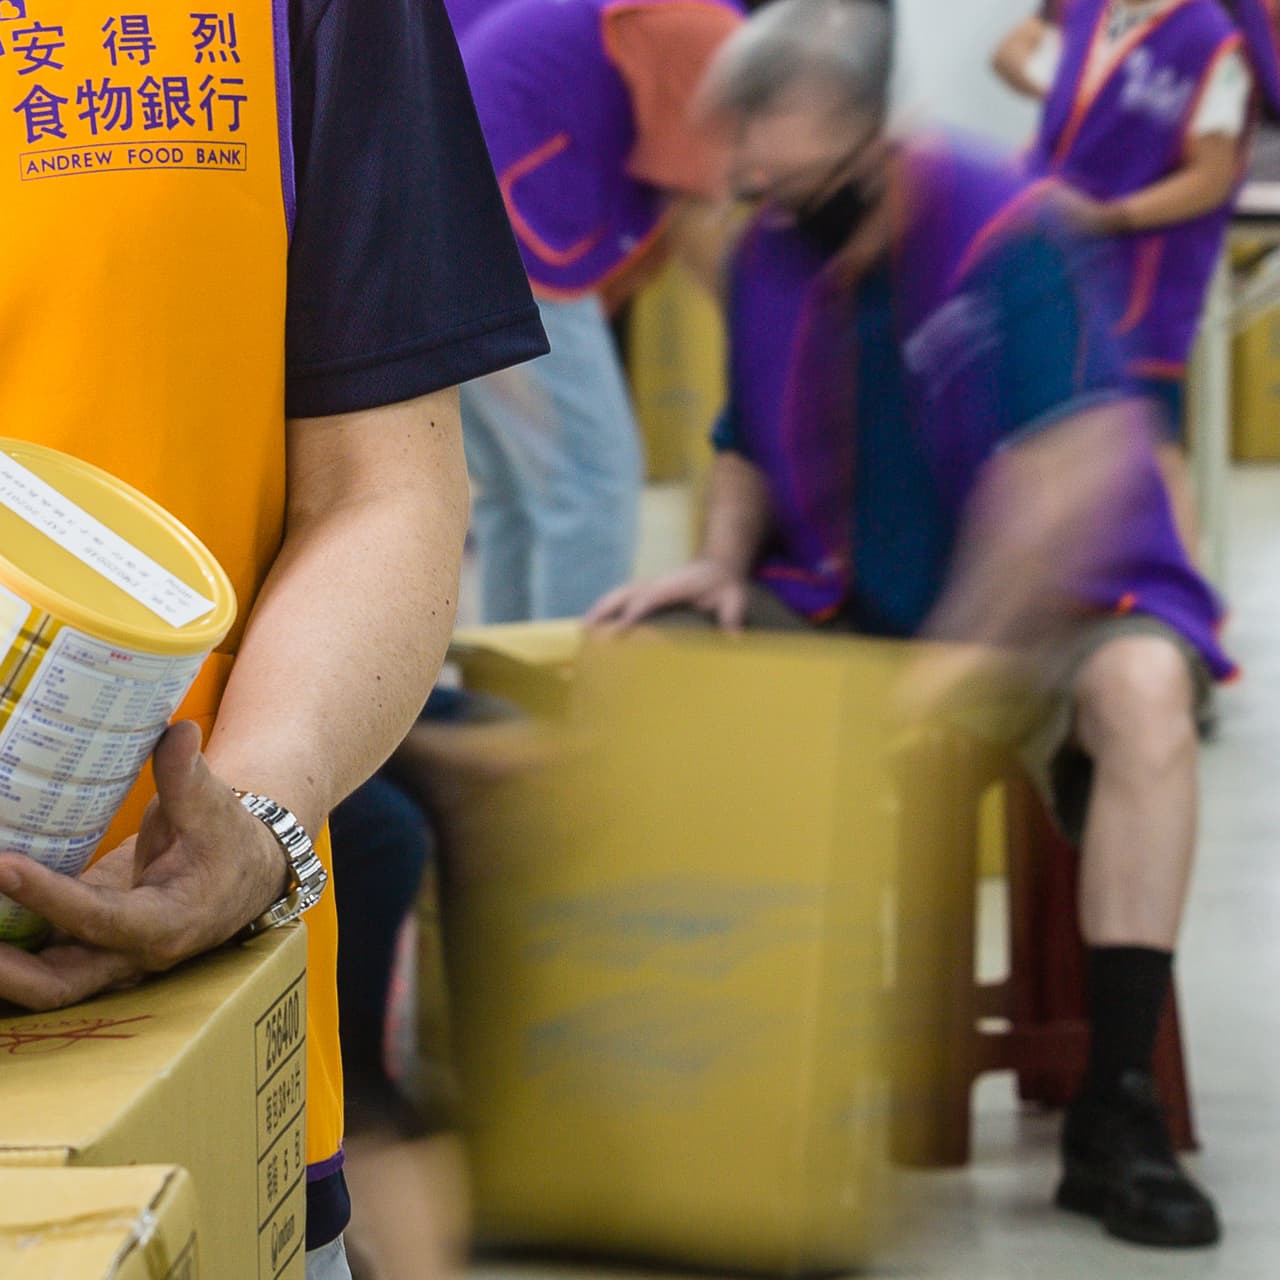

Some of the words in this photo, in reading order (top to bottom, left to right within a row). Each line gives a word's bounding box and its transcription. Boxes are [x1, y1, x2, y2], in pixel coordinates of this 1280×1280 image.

[11, 12, 242, 76] 安得烈
[13, 73, 249, 145] 食物銀行
[25, 150, 114, 175] ANDREW
[127, 147, 184, 165] FOOD
[196, 148, 242, 166] BANK
[265, 989, 300, 1072] 256400
